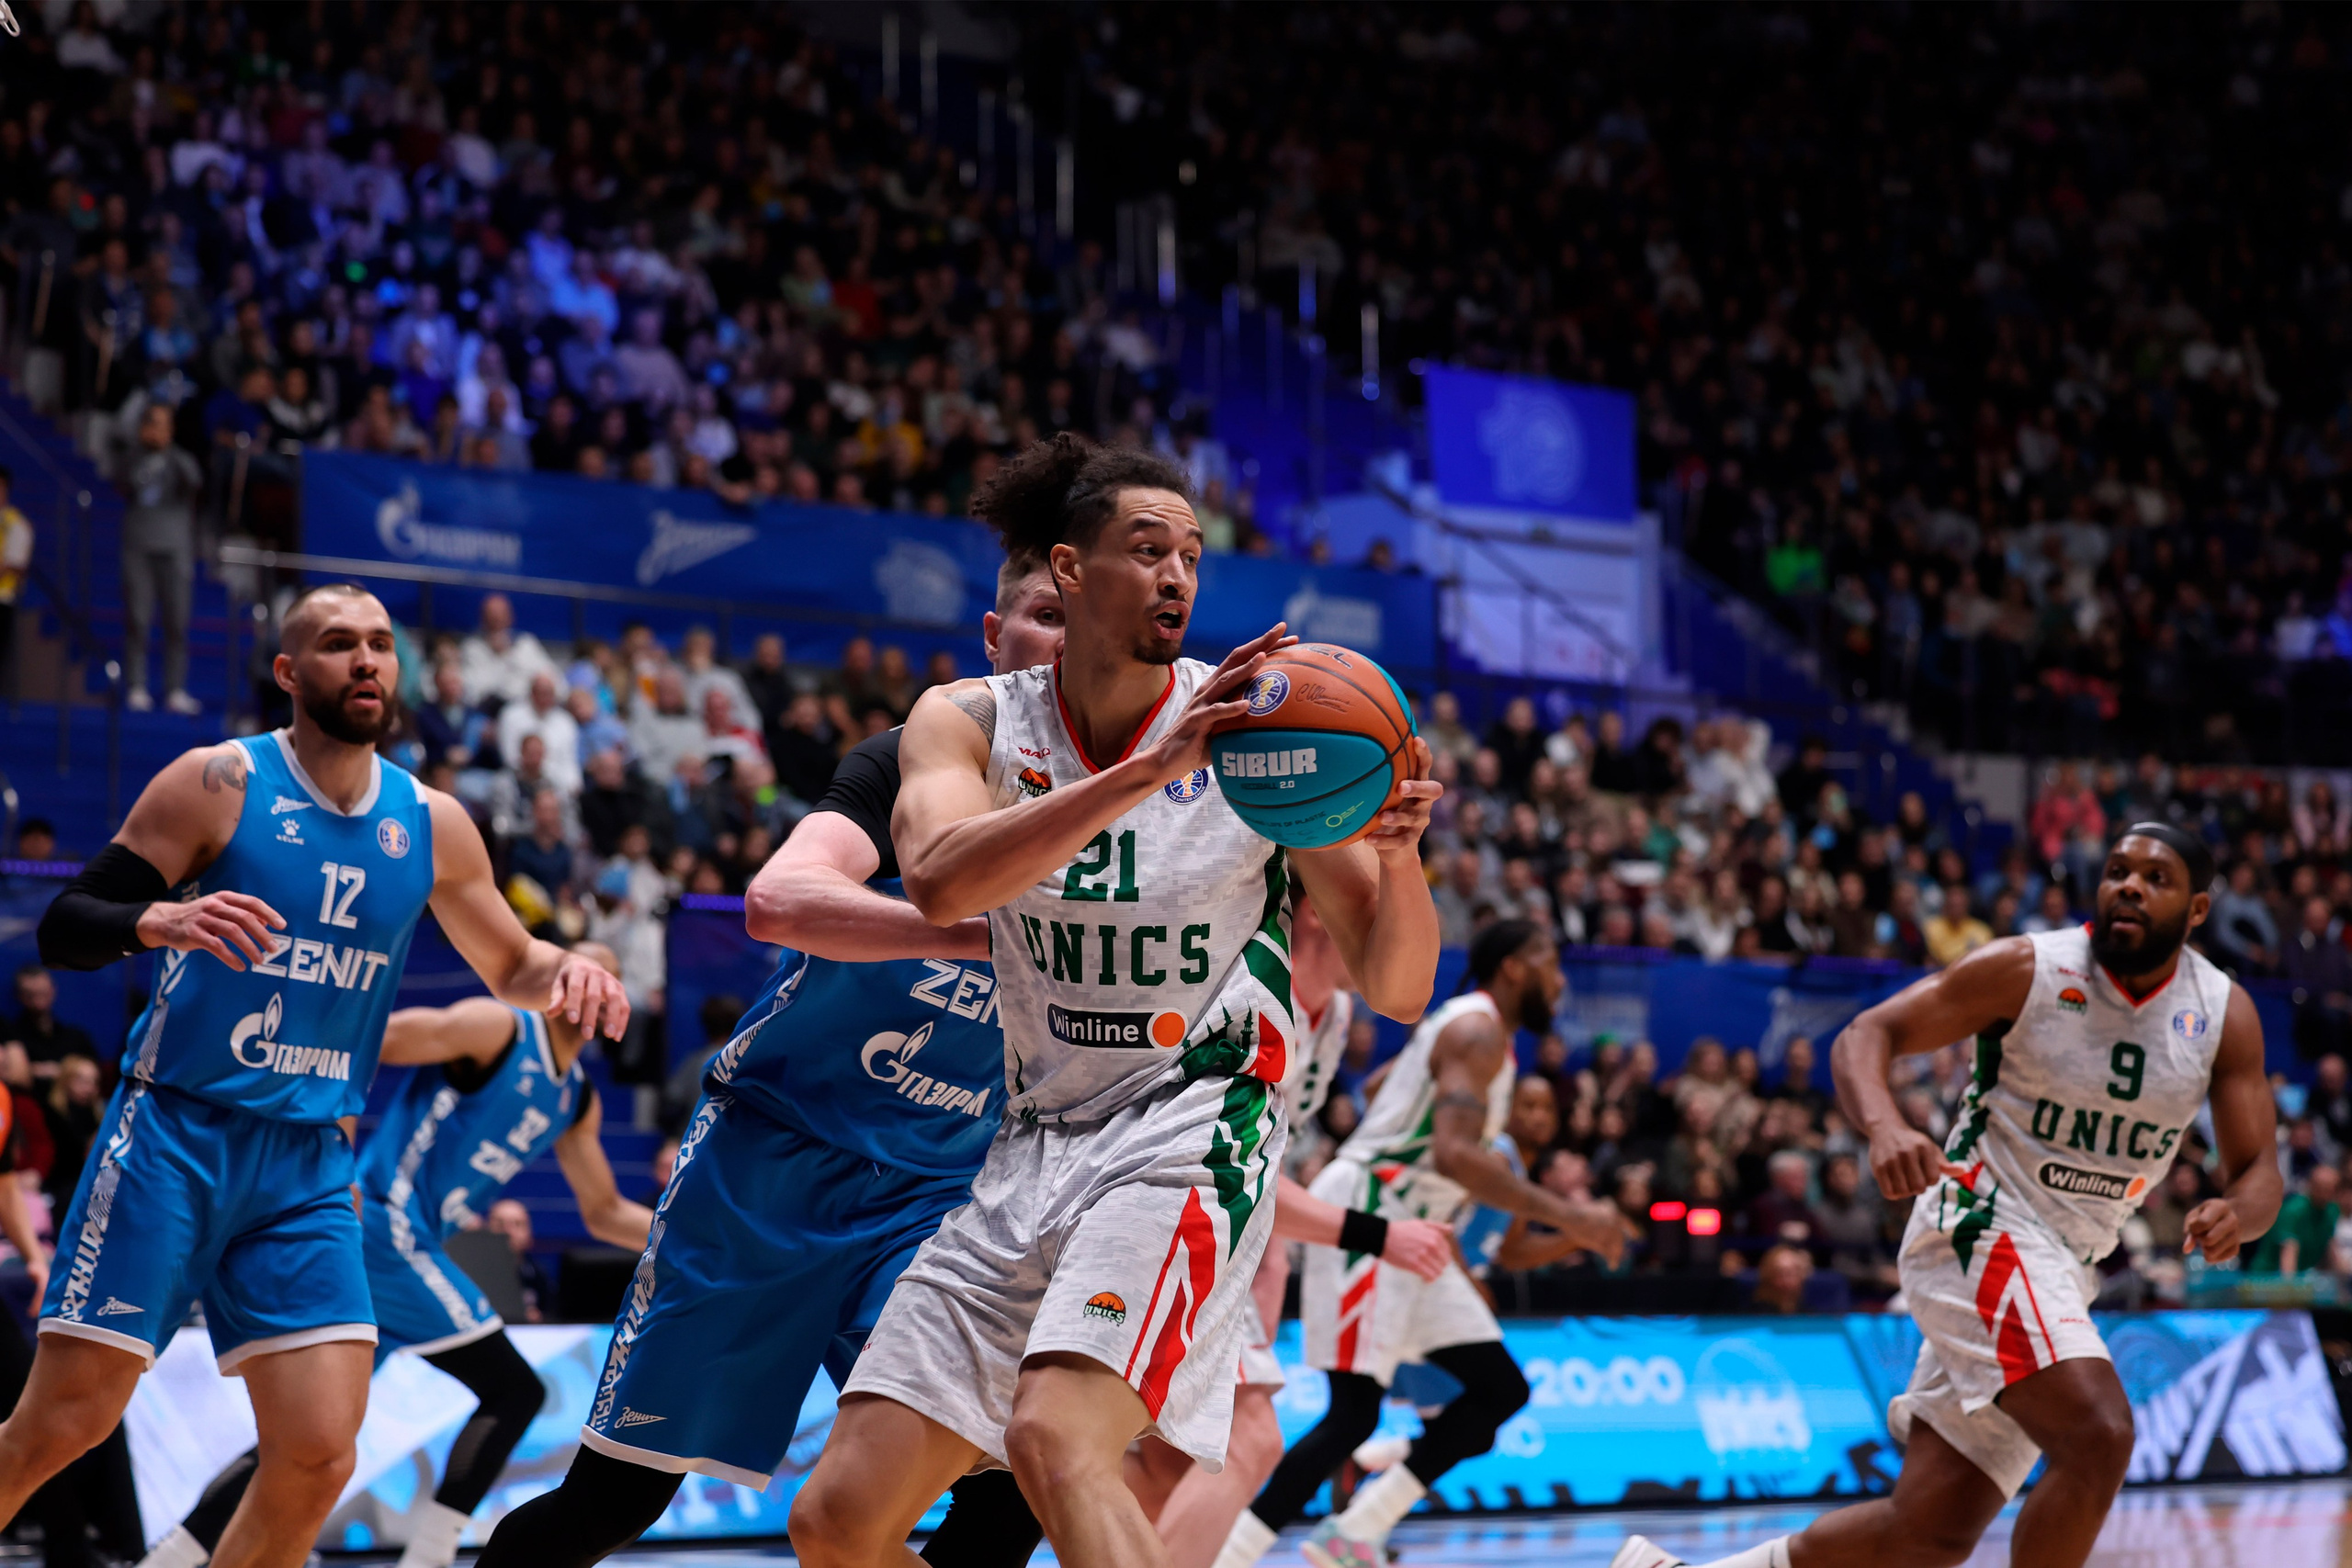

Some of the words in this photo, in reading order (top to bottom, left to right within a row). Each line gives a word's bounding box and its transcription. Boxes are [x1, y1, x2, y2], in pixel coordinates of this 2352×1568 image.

[1222, 748, 1317, 778] SIBUR
[1280, 780, 1295, 789] 2.0
[1295, 811, 1326, 826] PLASTIC
[1061, 829, 1140, 903] 21
[319, 861, 367, 930] 12
[251, 932, 390, 991] ZENIT
[1019, 912, 1211, 987] UNICS
[1051, 1008, 1140, 1043] Winline
[272, 1043, 352, 1082] ГАЗПРОМ
[2107, 1041, 2146, 1102] 9
[2030, 1098, 2181, 1160] UNICS
[2048, 1165, 2124, 1199] Winline
[1084, 1304, 1125, 1325] UNICS
